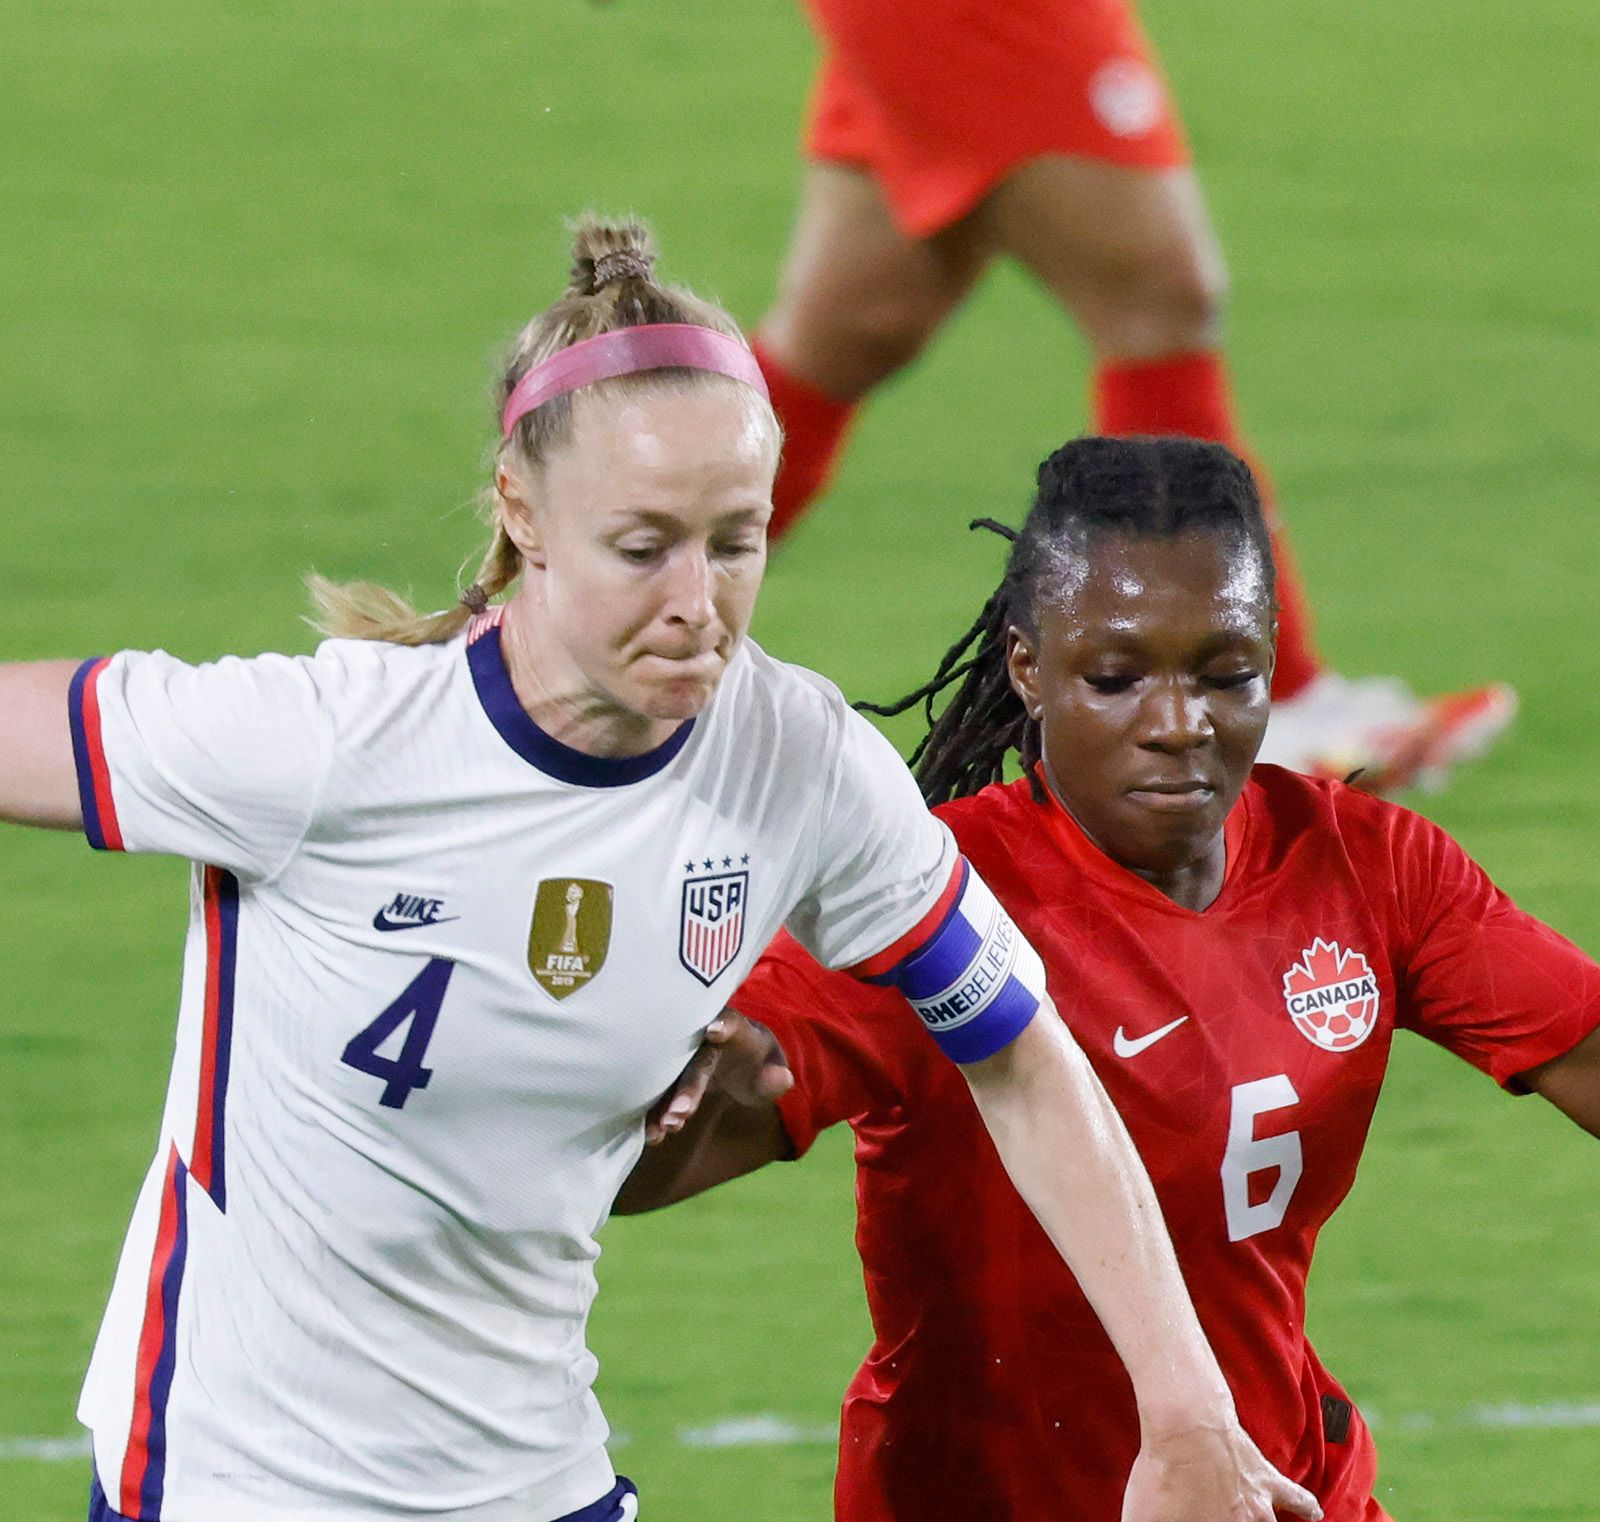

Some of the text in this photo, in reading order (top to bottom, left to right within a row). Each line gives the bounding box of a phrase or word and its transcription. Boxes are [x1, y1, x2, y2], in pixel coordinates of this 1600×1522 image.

[387, 892, 444, 923] NIKE
[689, 882, 742, 922] USA
[1290, 979, 1374, 1014] CANADA
[340, 957, 455, 1110] 4
[1220, 1073, 1303, 1243] 6
